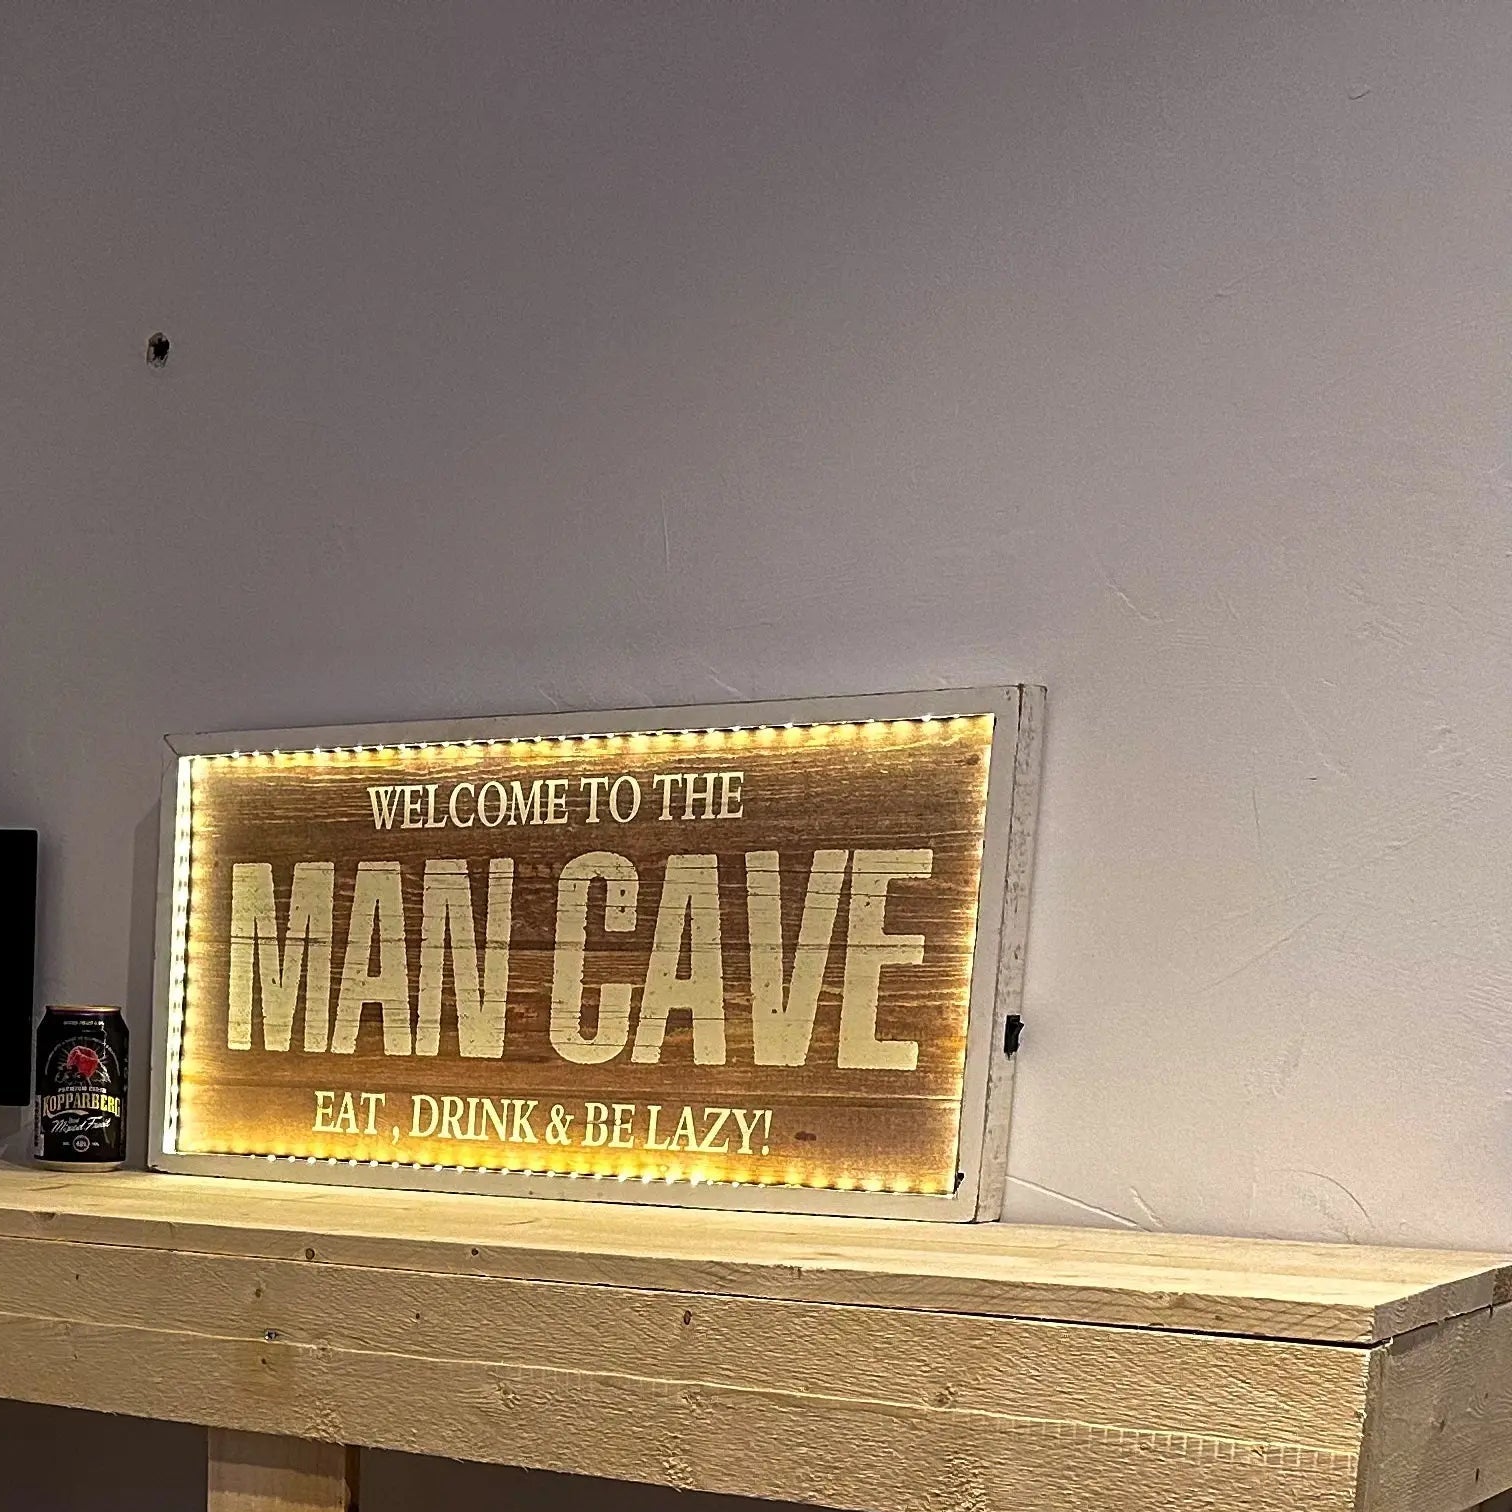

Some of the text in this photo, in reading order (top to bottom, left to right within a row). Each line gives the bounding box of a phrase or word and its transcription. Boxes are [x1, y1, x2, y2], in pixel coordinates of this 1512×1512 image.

[366, 771, 746, 831] WELCOME TO THE
[226, 849, 934, 1071] MAN CAVE
[42, 1092, 121, 1118] KOPPARBERG
[408, 1094, 539, 1144] DRINK
[545, 1103, 575, 1146] &
[581, 1102, 636, 1149] BE
[643, 1104, 773, 1156] LAZY!
